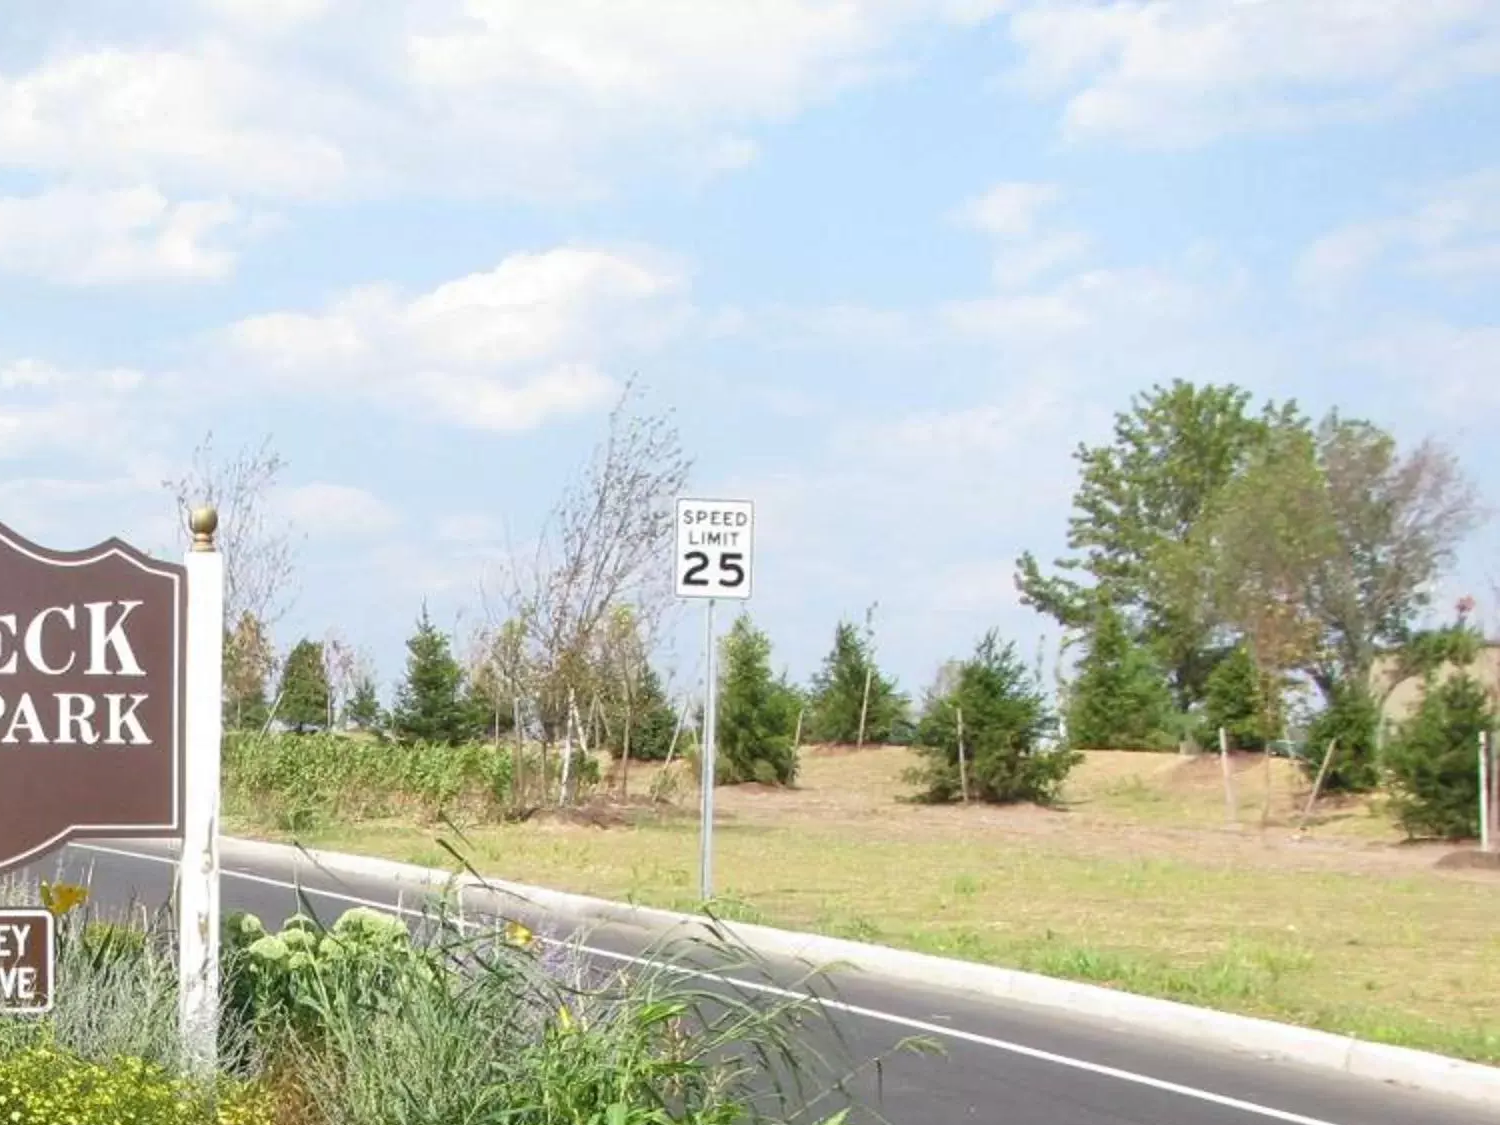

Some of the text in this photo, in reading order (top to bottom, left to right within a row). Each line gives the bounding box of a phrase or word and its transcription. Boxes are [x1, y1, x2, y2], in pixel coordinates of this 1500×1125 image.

[683, 509, 748, 527] SPEED
[688, 531, 740, 547] LIMIT
[682, 551, 745, 588] 25
